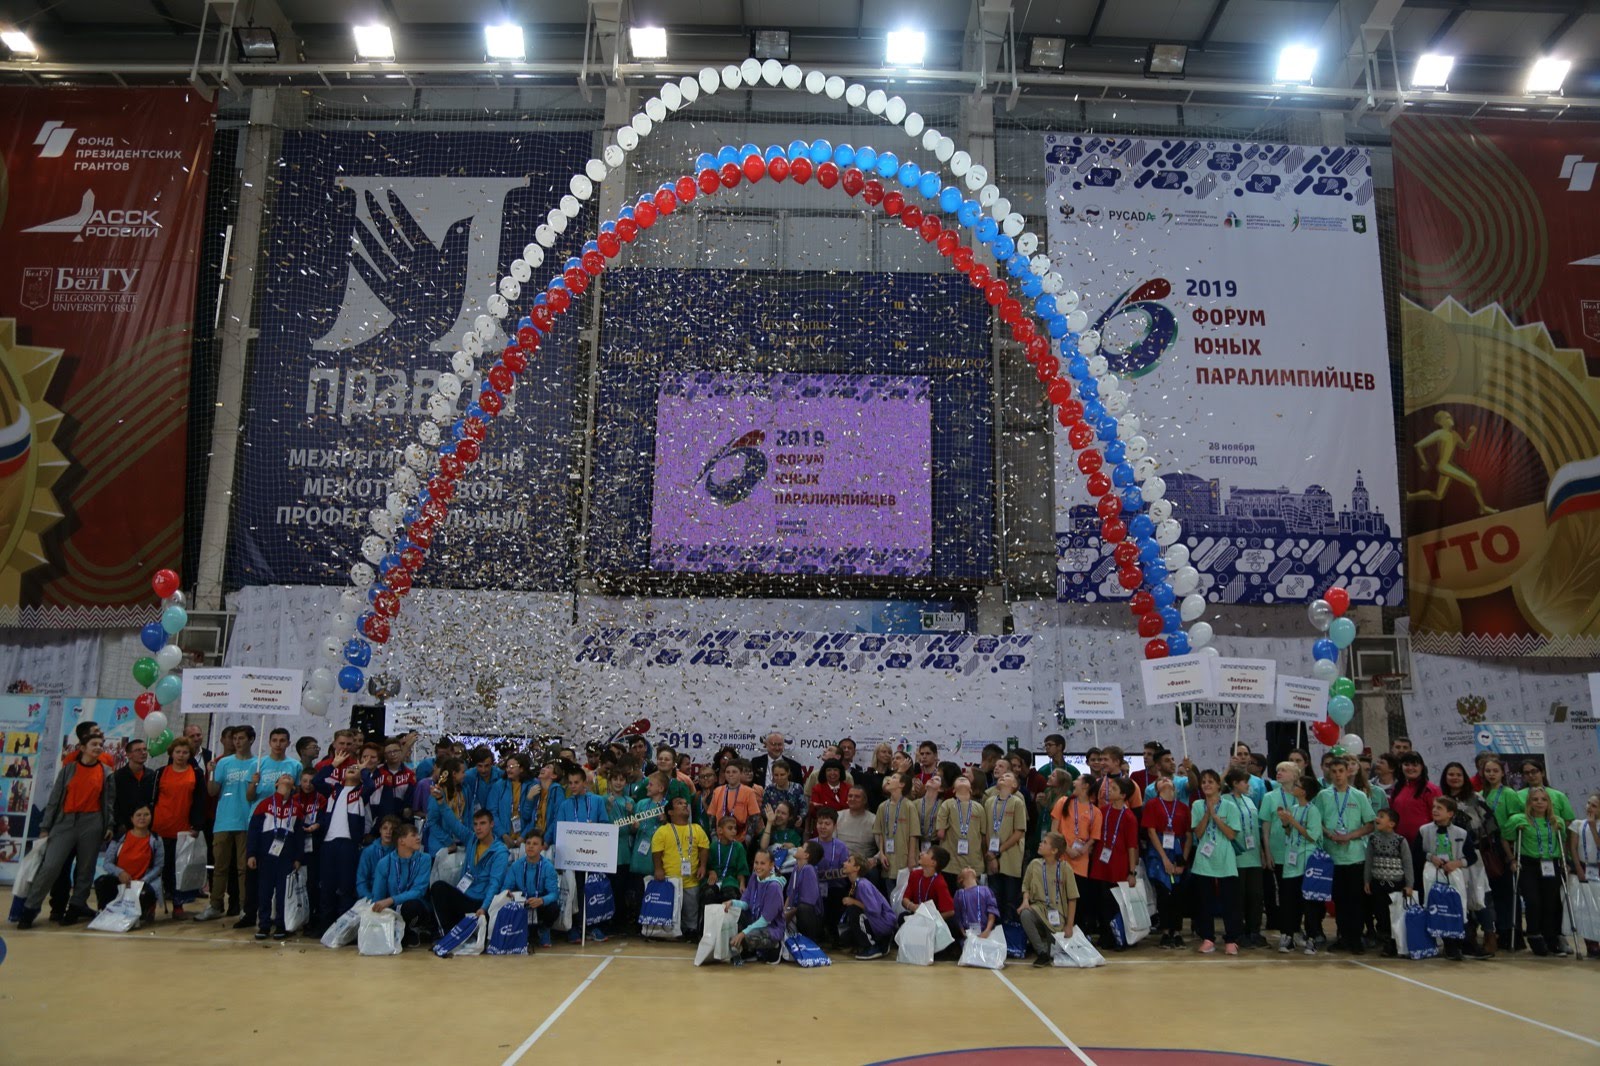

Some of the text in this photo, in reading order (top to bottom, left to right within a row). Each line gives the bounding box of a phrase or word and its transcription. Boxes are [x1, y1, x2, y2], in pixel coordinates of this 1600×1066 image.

[77, 136, 114, 147] ФОНД
[75, 149, 182, 160] ПРЕЗИДЕНТСКИХ
[74, 161, 130, 172] ГРАНТОВ
[88, 209, 160, 225] АССК
[85, 227, 159, 238] РОССИИ
[76, 267, 100, 276] НИУ
[55, 267, 140, 291] БелГУ
[1186, 279, 1238, 298] 2019
[53, 293, 138, 303] BELGOROD STATE
[52, 303, 137, 313] UNIVERSITY (BSU)
[1191, 307, 1266, 327] ФОРУМ
[1194, 337, 1262, 356] ЮНЫХ
[1195, 366, 1376, 391] ПАРАЛИМПИЙЦЕВ
[776, 429, 825, 447] 2019
[1208, 442, 1255, 453] 28 ноября
[775, 453, 824, 466] ФОРУМ
[1209, 455, 1258, 466] БЕЛГОРОД
[775, 472, 820, 485] ЮНЫХ
[775, 491, 897, 508] ПАРАЛИМПИЙЦЕВ
[1421, 525, 1521, 581] ГТО
[658, 732, 703, 749] 2019
[728, 733, 756, 741] НОЯБРЯ
